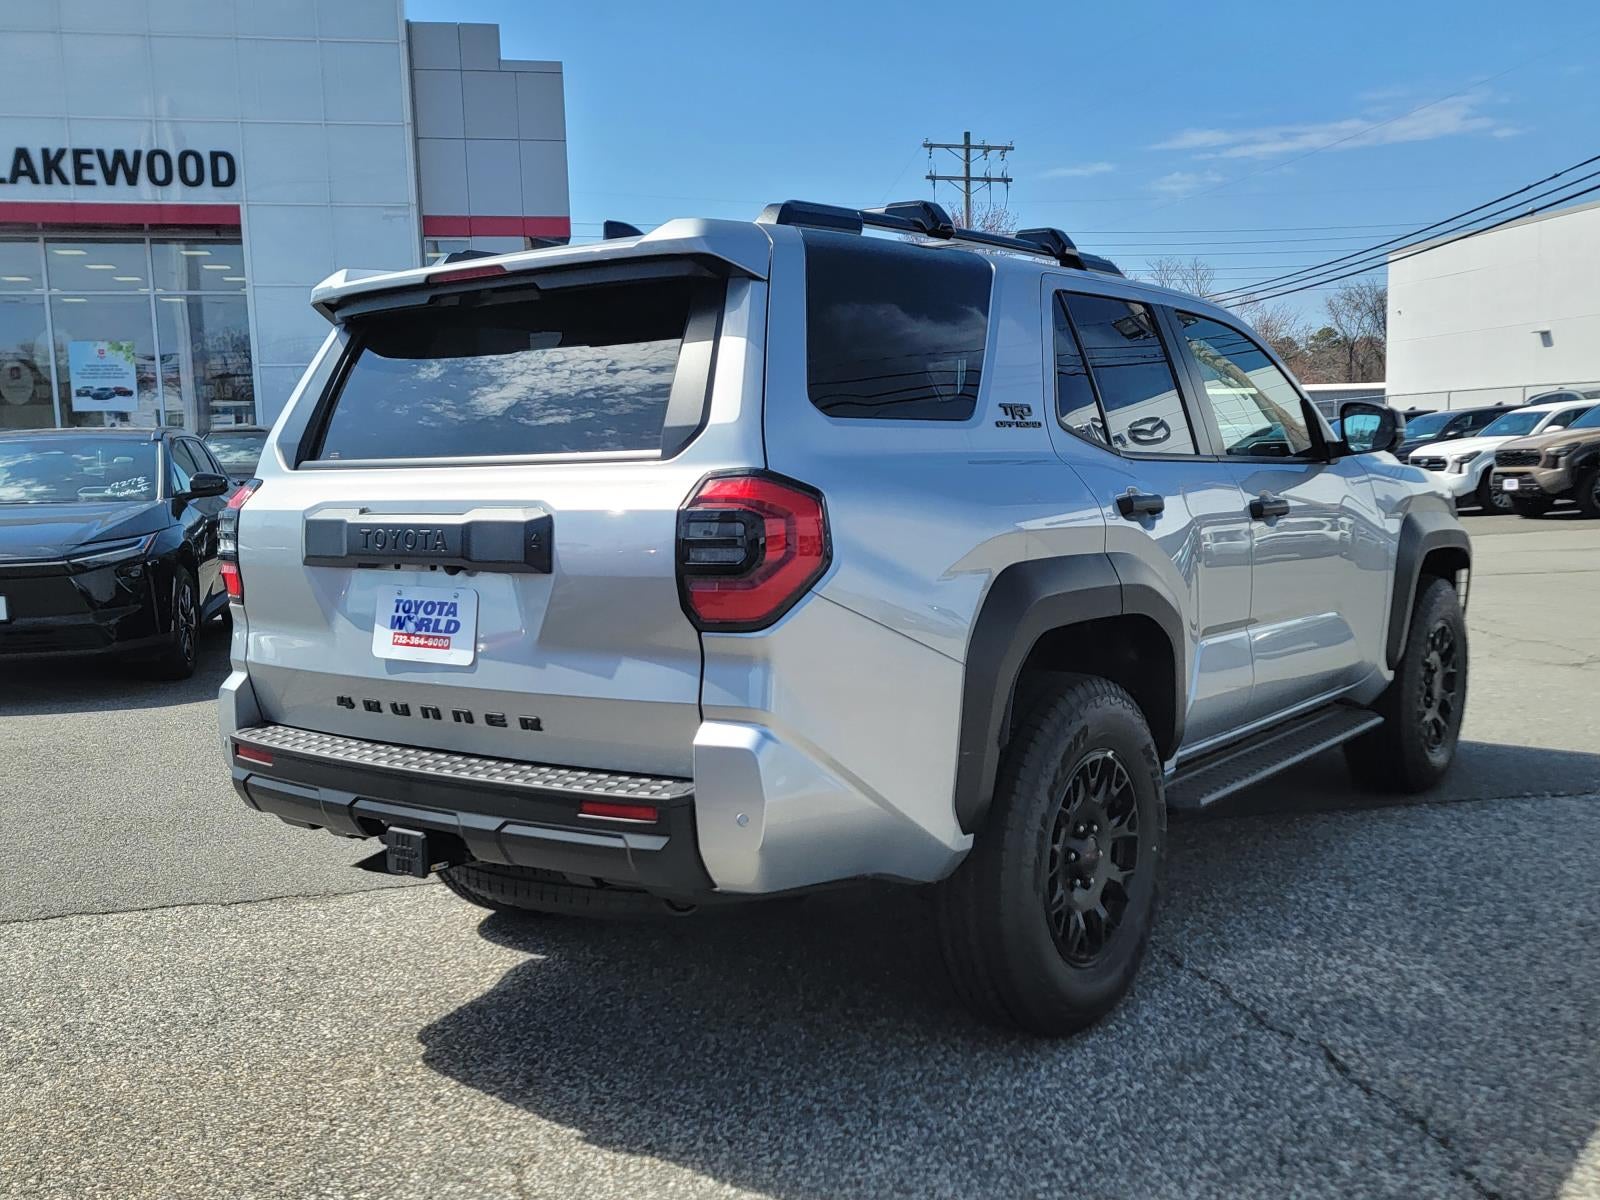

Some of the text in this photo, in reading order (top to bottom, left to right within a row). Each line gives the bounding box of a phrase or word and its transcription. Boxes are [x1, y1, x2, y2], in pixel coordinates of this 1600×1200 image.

[0, 147, 236, 188] AKEWOOD
[998, 403, 1033, 420] TRD
[360, 528, 448, 551] TOYOTA
[394, 599, 458, 617] TOYOTA
[336, 696, 543, 731] 4RUNNER
